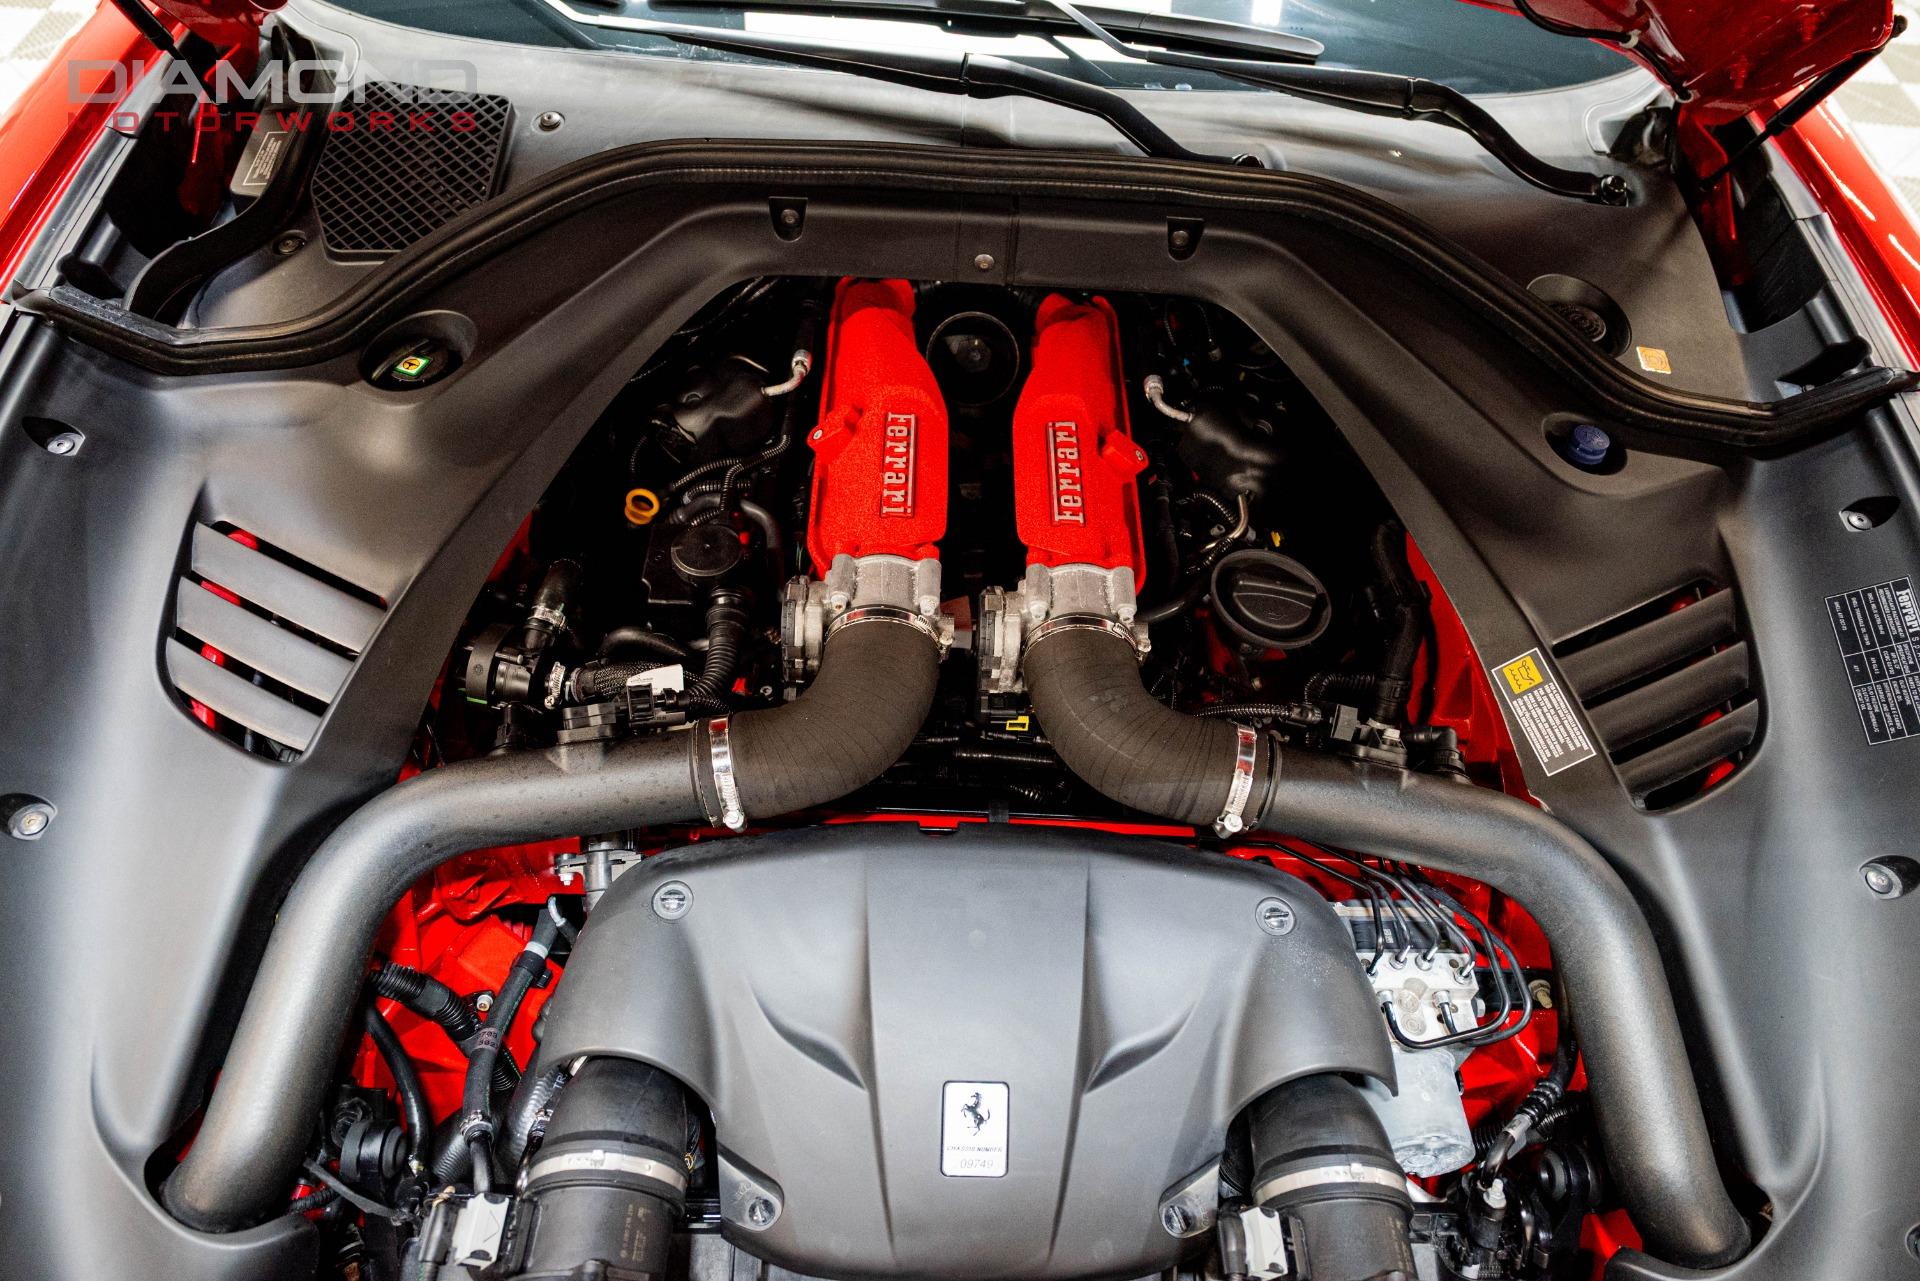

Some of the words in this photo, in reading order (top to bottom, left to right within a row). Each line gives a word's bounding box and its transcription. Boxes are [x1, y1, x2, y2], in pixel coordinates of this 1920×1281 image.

[883, 412, 915, 514] Ferrari
[1047, 421, 1084, 525] Ferrari
[1895, 588, 1920, 633] Ferrari
